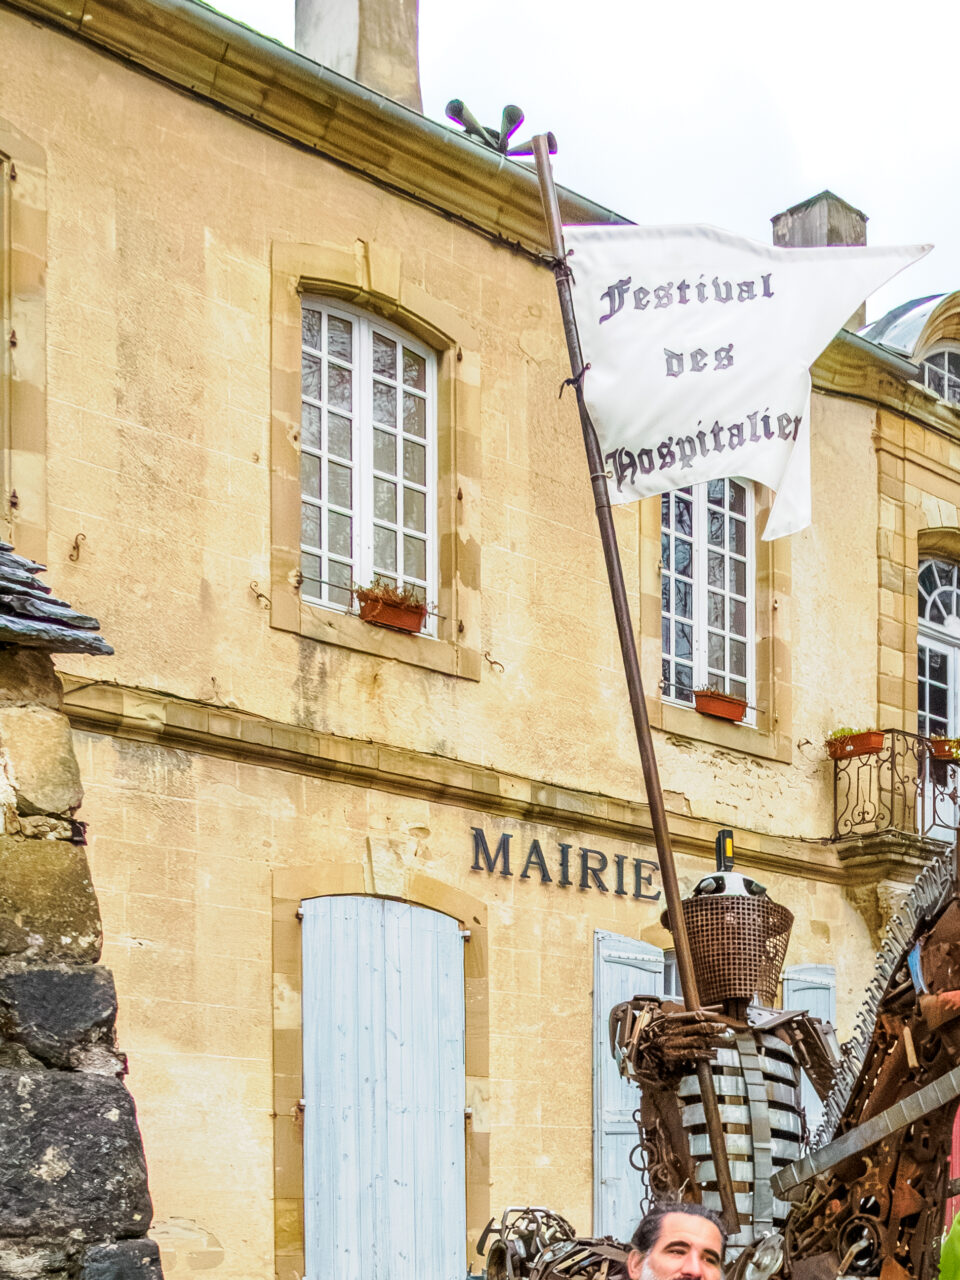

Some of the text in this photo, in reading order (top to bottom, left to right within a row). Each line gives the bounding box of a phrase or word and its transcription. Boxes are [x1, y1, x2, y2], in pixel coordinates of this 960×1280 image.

[599, 273, 774, 324] Festival
[663, 342, 734, 378] des
[470, 827, 662, 900] MAIRIE
